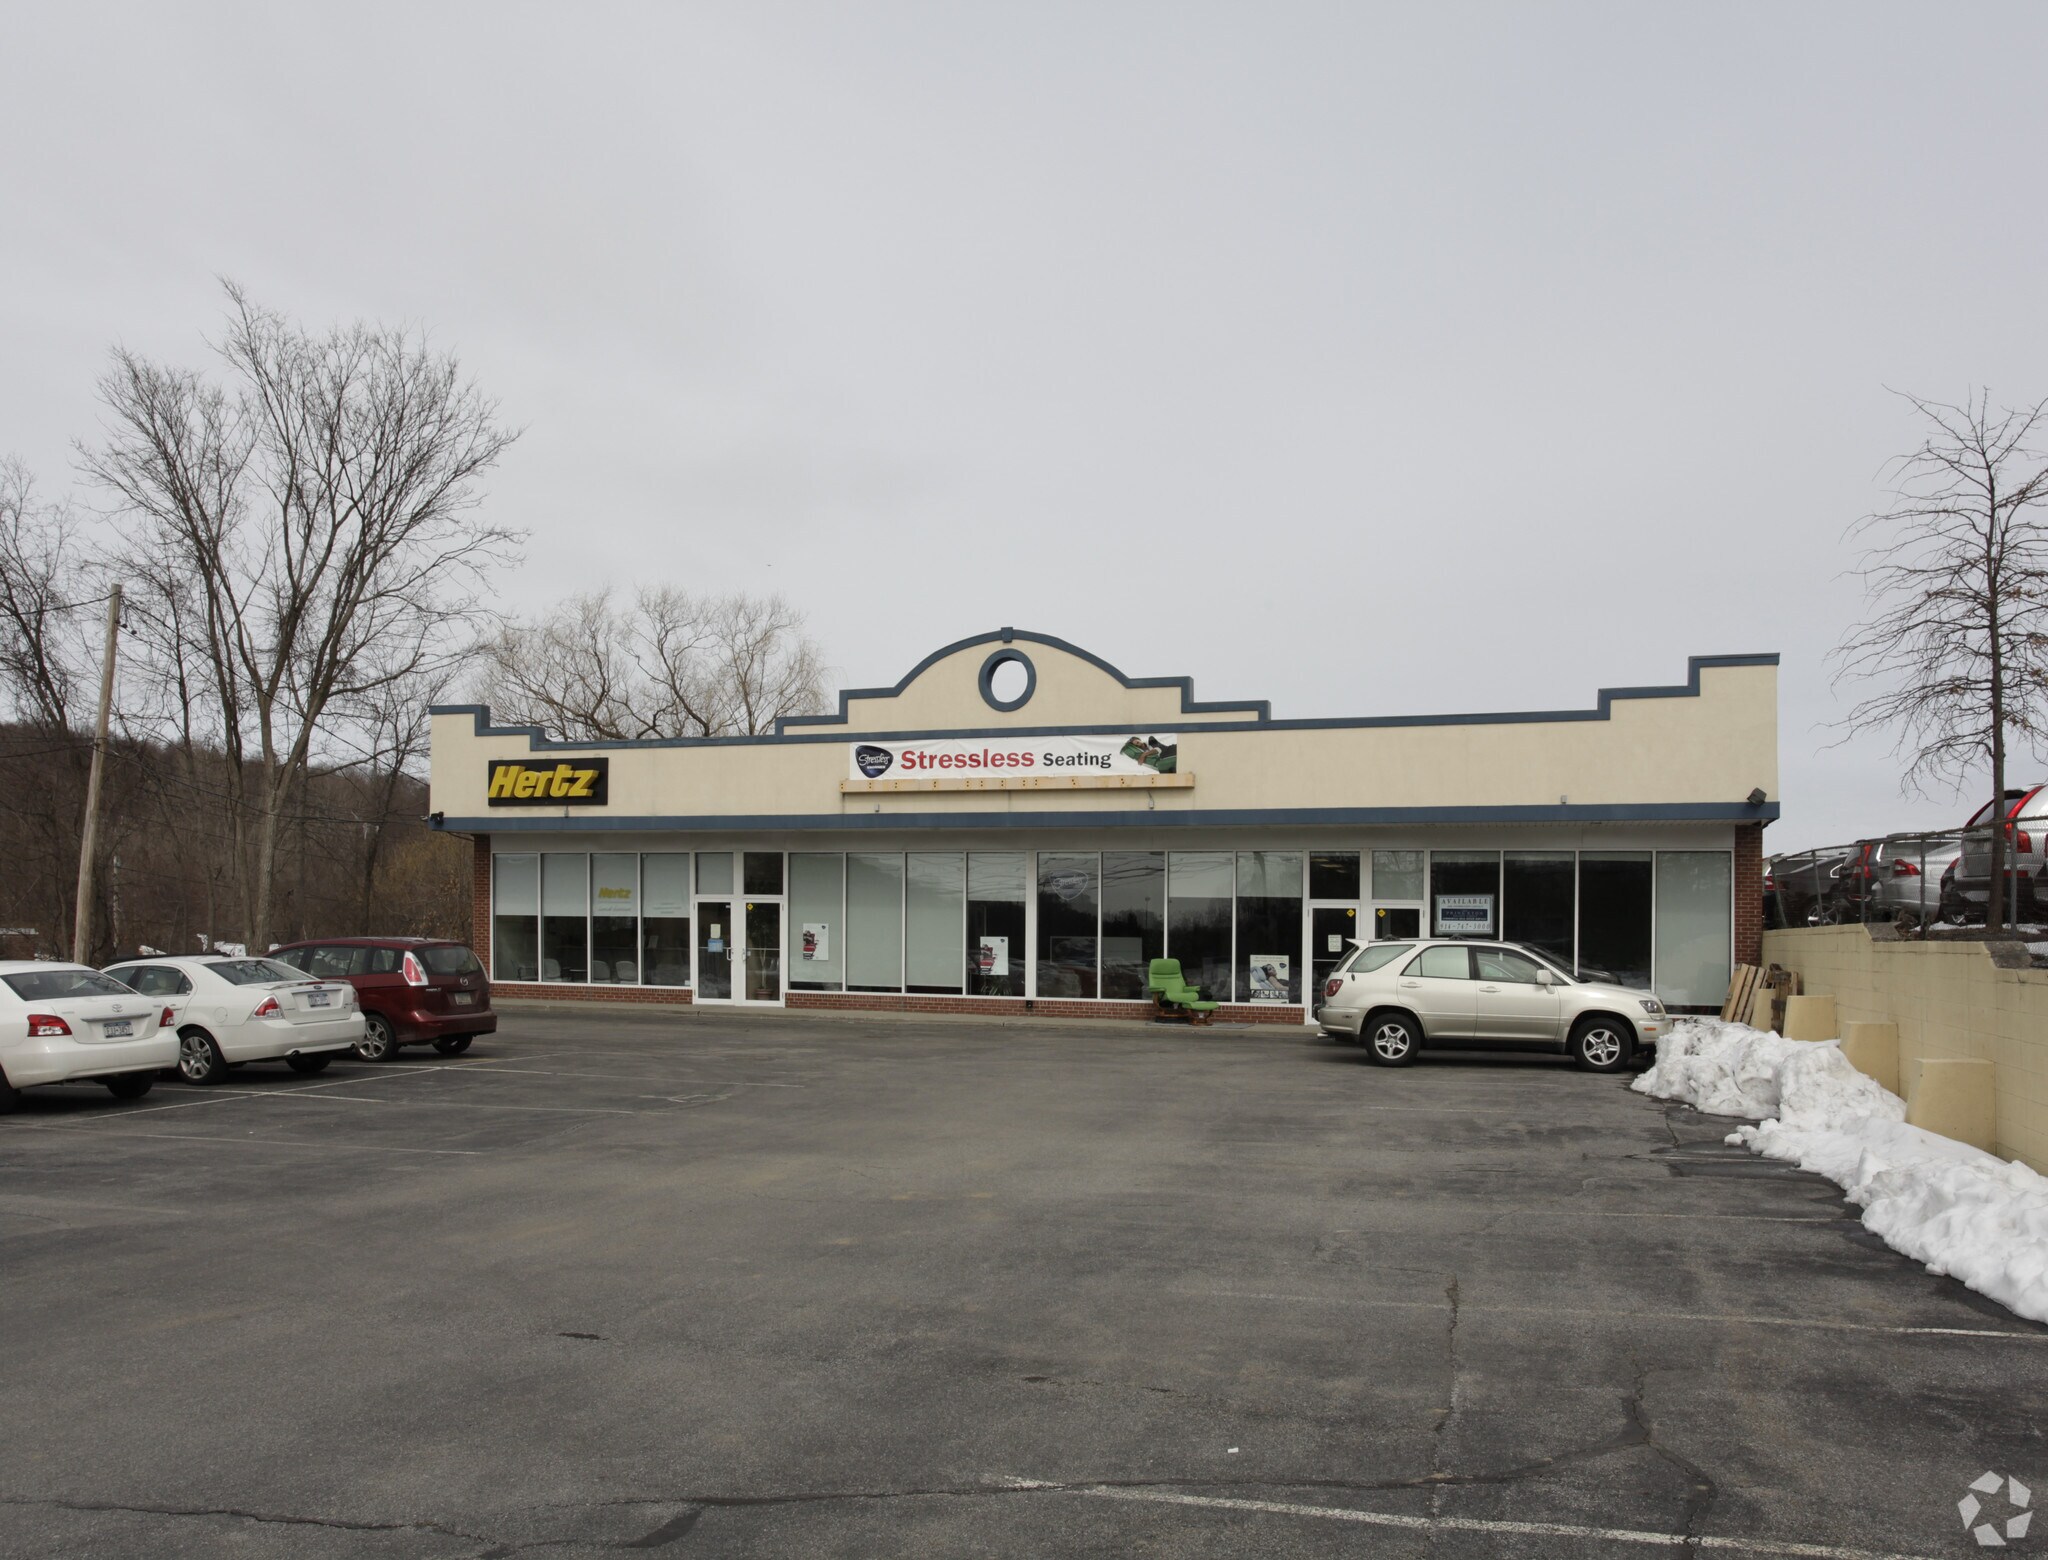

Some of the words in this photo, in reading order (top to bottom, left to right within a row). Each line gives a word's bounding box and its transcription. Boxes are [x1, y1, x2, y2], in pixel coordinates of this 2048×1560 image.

[901, 748, 1035, 770] Stressless
[1042, 751, 1112, 769] Seating
[488, 764, 600, 799] Hertz
[598, 887, 632, 898] Hertz
